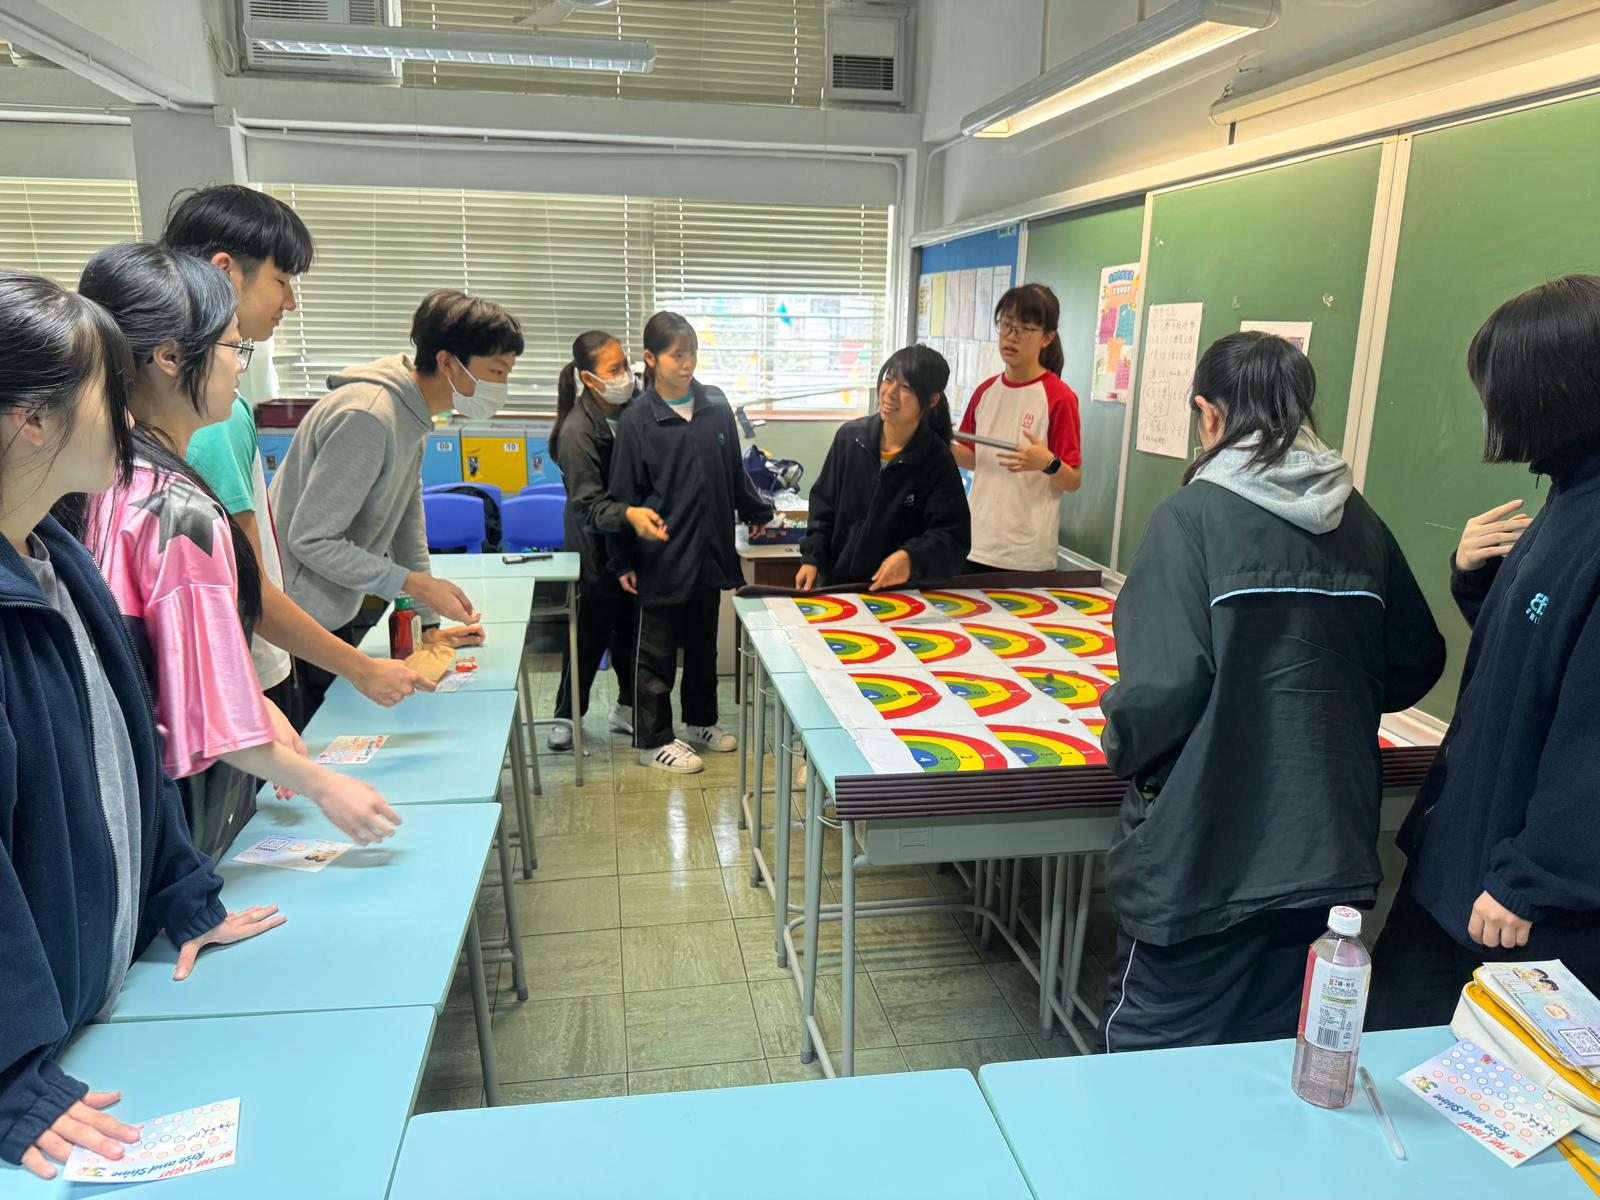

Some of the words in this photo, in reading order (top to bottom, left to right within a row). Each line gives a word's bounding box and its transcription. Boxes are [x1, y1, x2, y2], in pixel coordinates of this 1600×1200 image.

[1433, 1093, 1464, 1112] Shine
[1461, 1109, 1485, 1125] and
[1457, 1122, 1492, 1142] LIGHT
[1484, 1123, 1509, 1139] Rise
[1487, 1135, 1510, 1151] THE
[178, 1151, 205, 1165] Rise
[195, 1155, 216, 1166] THE
[219, 1150, 234, 1158] BE
[1508, 1149, 1527, 1160] BE
[111, 1166, 146, 1179] Shine
[150, 1158, 176, 1172] and
[159, 1160, 194, 1179] LIGHT
